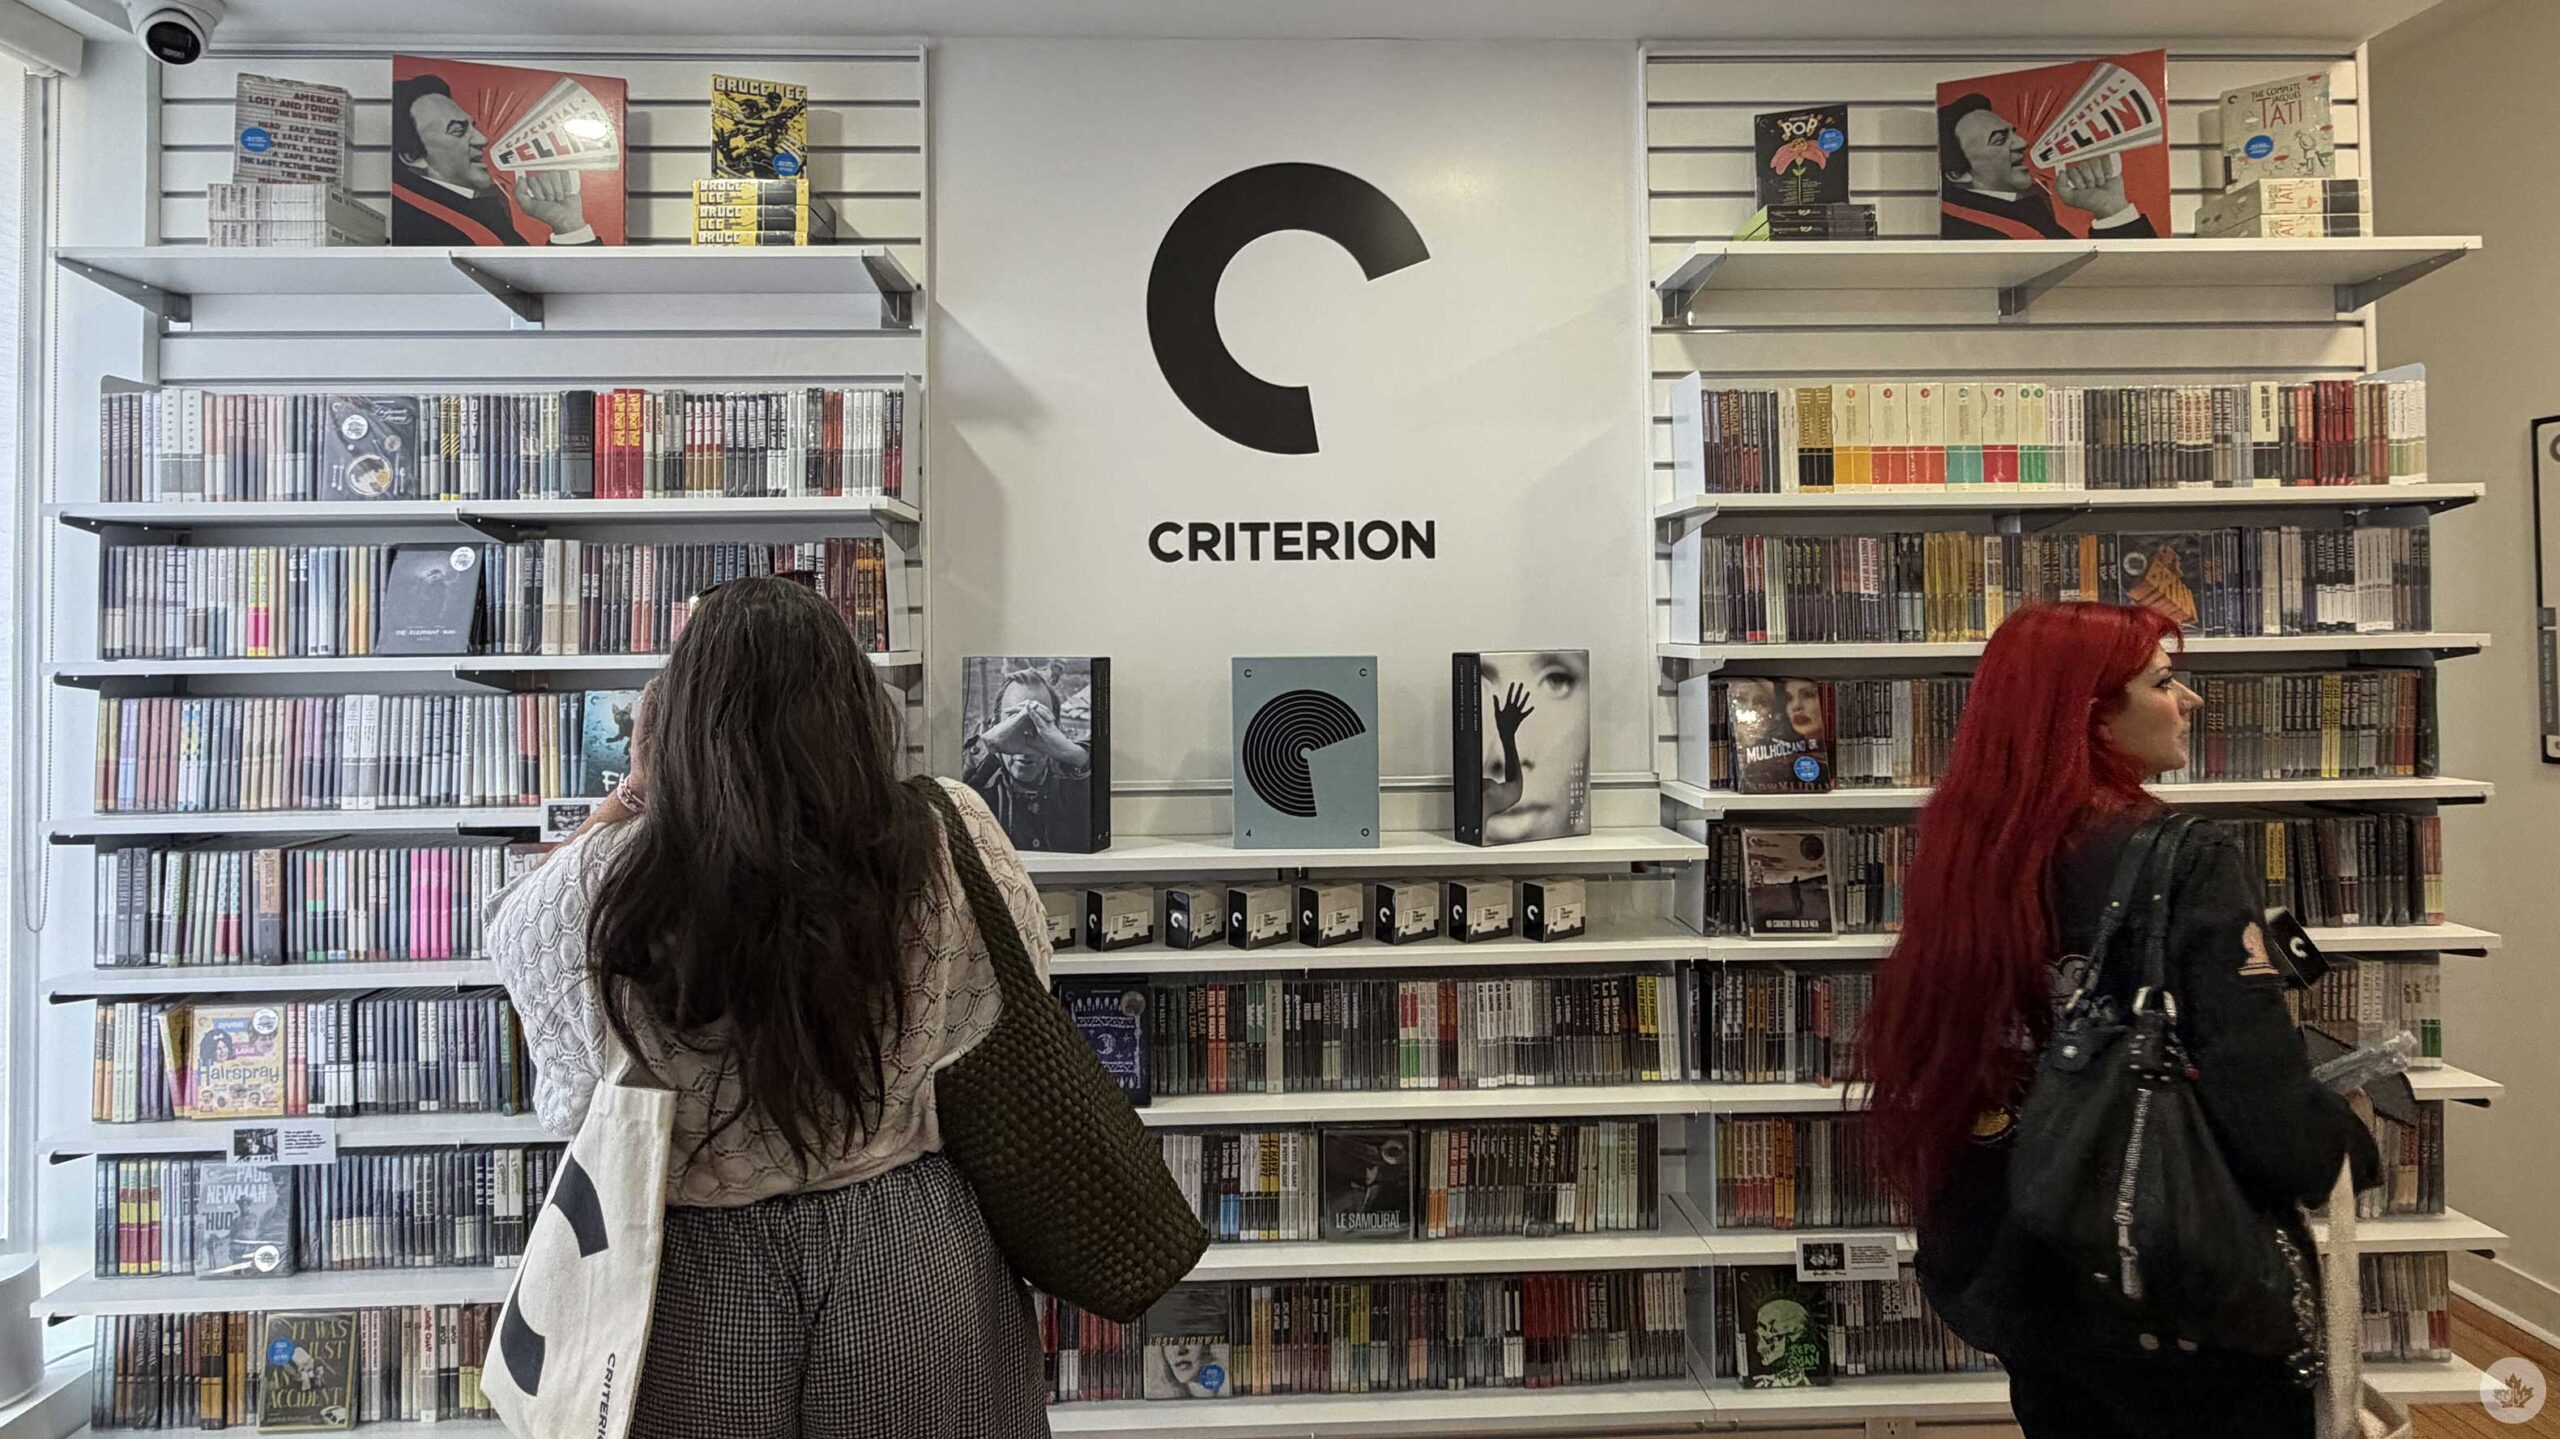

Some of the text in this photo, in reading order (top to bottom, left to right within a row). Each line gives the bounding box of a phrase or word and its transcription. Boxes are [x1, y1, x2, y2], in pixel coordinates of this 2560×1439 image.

[715, 77, 770, 96] BRUCE
[2252, 83, 2301, 101] THE COMPLETE
[249, 96, 340, 115] LOST AND FOUND
[293, 93, 339, 105] AMERICA
[2257, 98, 2303, 129] TATI
[1783, 119, 1817, 136] POP
[2039, 89, 2153, 162] FELLINI
[282, 133, 303, 143] EASY
[240, 155, 255, 164] THE
[256, 157, 277, 167] LAST
[279, 160, 312, 170] PICTURE
[282, 152, 305, 161] SAFE
[309, 155, 337, 165] PLACE
[700, 180, 742, 192] BRUCE
[2279, 183, 2294, 204] TATI
[700, 192, 723, 204] LEE
[699, 207, 742, 218] BRUCE
[700, 218, 723, 230] LEE
[697, 232, 741, 243] BRUCE
[1148, 520, 1436, 563] CRITERION
[1243, 668, 1368, 678] C C
[1245, 827, 1252, 837] 4
[198, 1059, 280, 1086] Hairspray
[237, 1166, 272, 1182] PAUL
[206, 1185, 267, 1204] NEWMAN
[1335, 1213, 1347, 1229] LE
[292, 1319, 348, 1340] IT WAS
[1177, 1334, 1226, 1346] HIGHWAY
[310, 1341, 344, 1361] JUST
[268, 1388, 342, 1410] ACCIDENT
